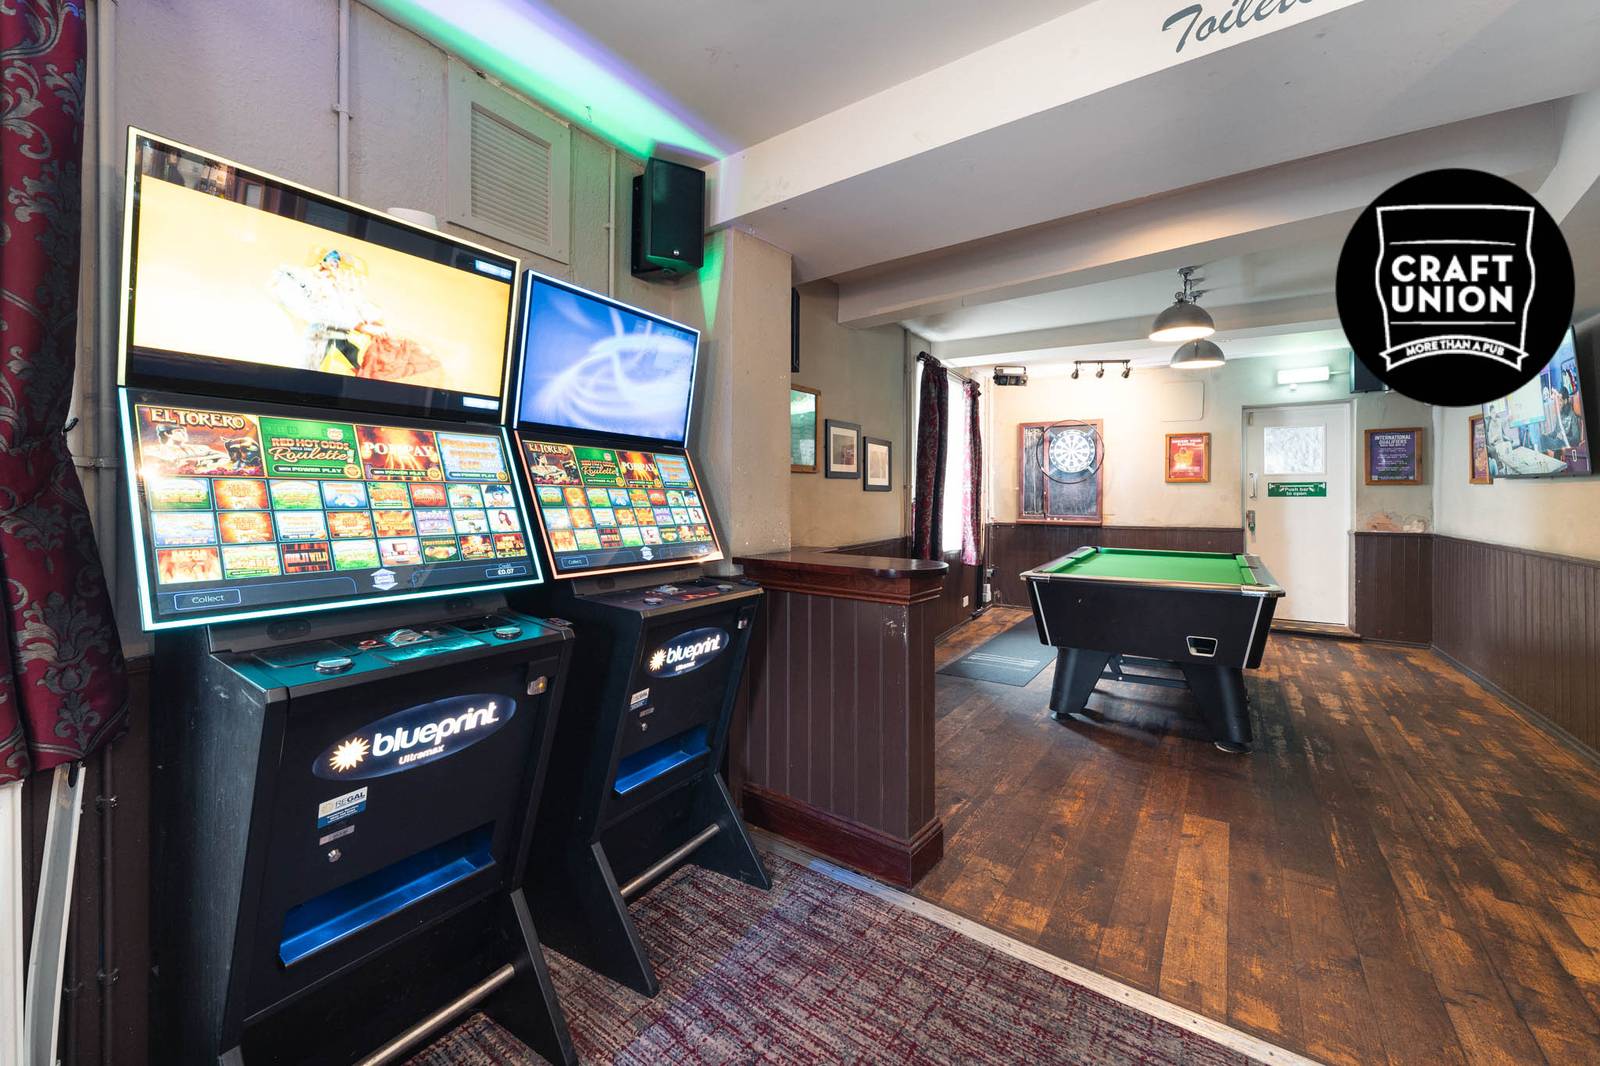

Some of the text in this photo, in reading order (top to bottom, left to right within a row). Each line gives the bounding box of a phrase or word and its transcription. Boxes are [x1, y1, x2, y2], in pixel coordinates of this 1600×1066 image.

[1162, 0, 1313, 53] Toile
[150, 407, 246, 430] EL TORERO
[271, 437, 295, 447] RED
[296, 438, 320, 448] HOT
[320, 440, 349, 451] ODDS
[192, 594, 224, 604] Collect
[666, 634, 720, 663] blueprint
[372, 701, 499, 757] blueprint
[335, 792, 366, 808] REGAL
